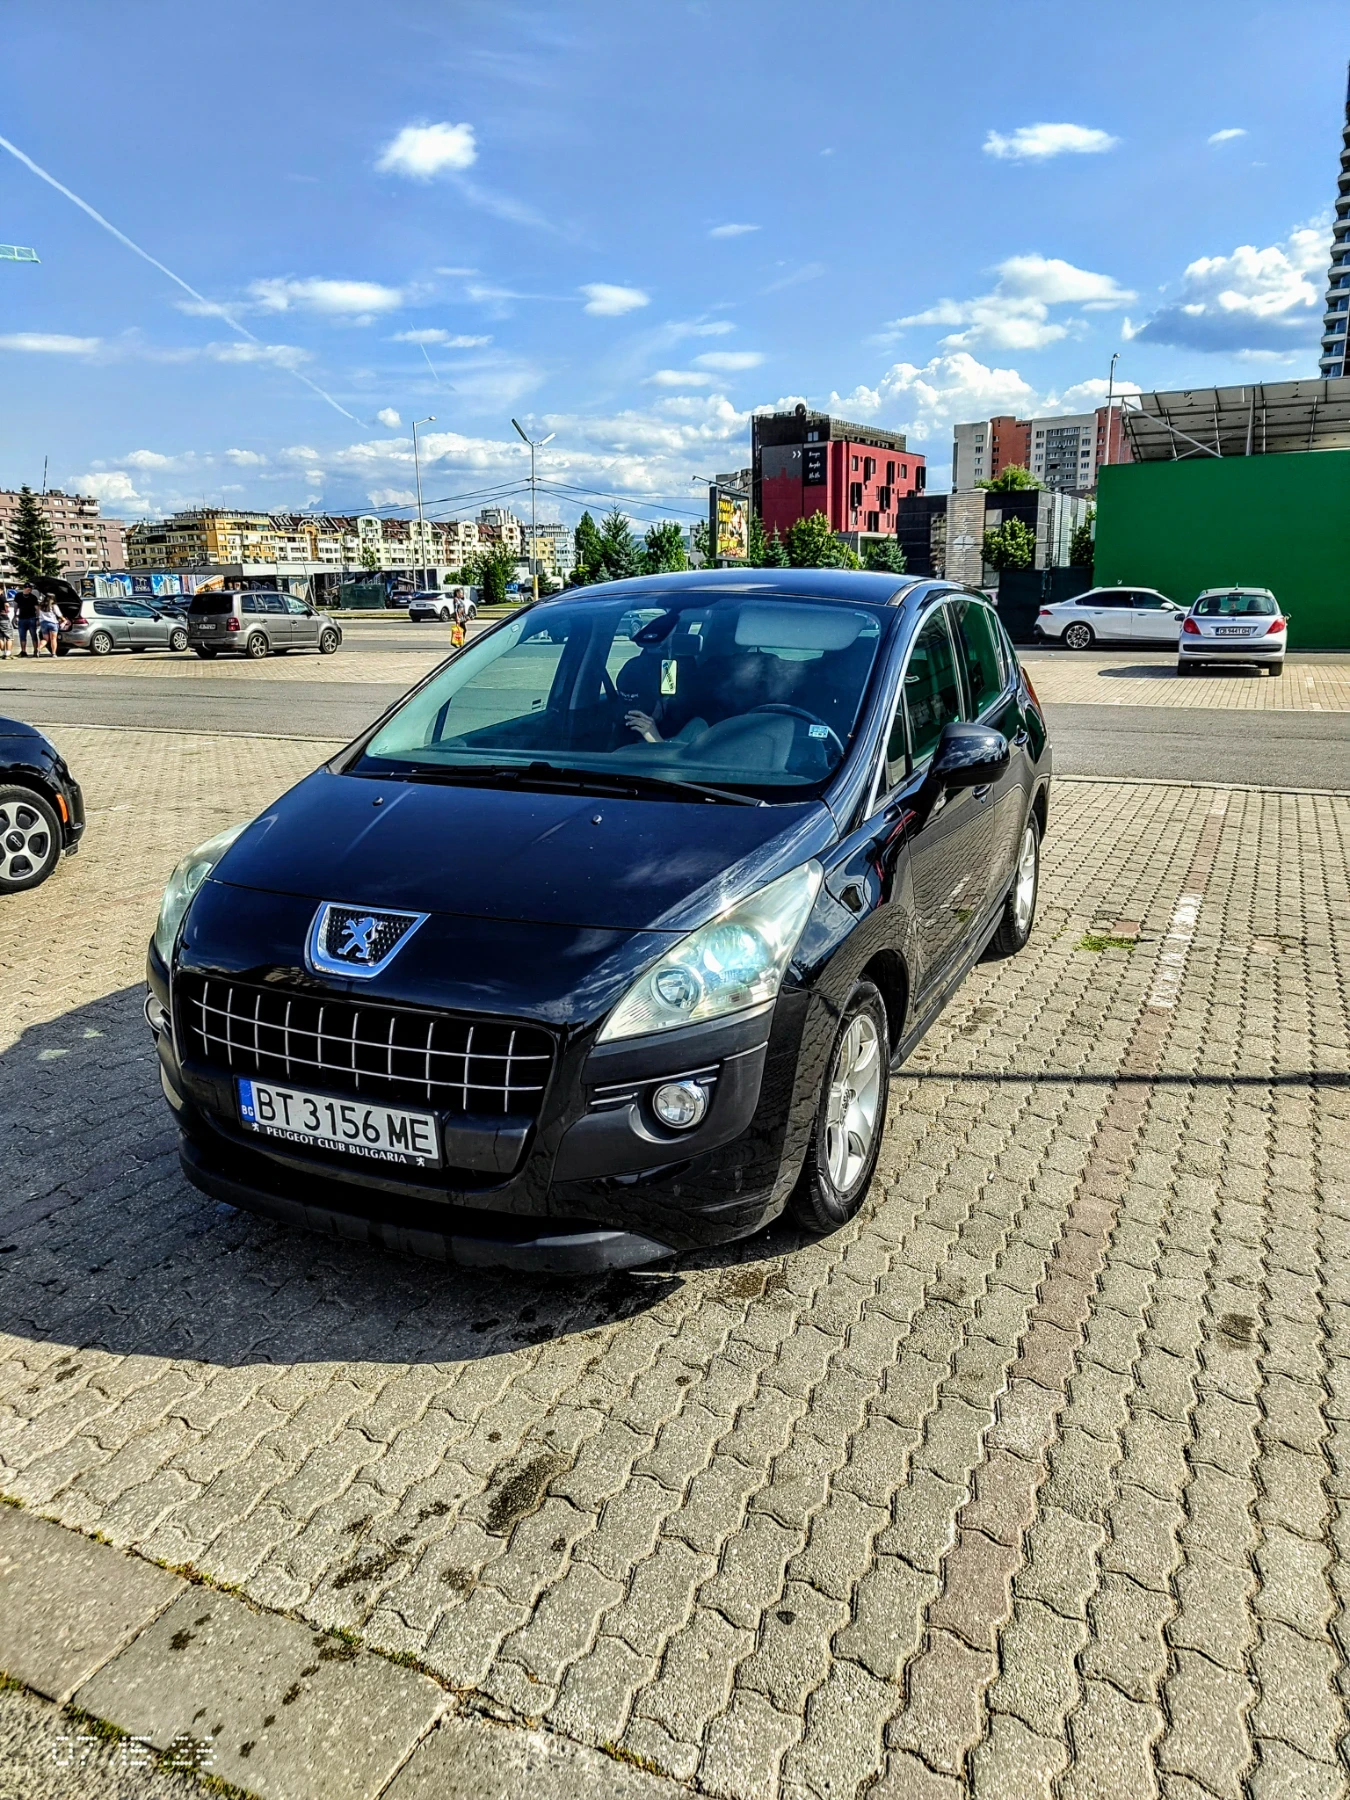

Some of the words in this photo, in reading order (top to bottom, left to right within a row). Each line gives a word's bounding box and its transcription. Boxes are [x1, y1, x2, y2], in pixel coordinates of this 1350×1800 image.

[241, 1105, 254, 1116] BG
[256, 1087, 294, 1126] BT
[303, 1098, 380, 1143] 3156
[386, 1113, 433, 1155] ME
[266, 1126, 314, 1145] PEUGEOT
[317, 1138, 346, 1152] CLUB
[348, 1145, 407, 1164] BULGARIA
